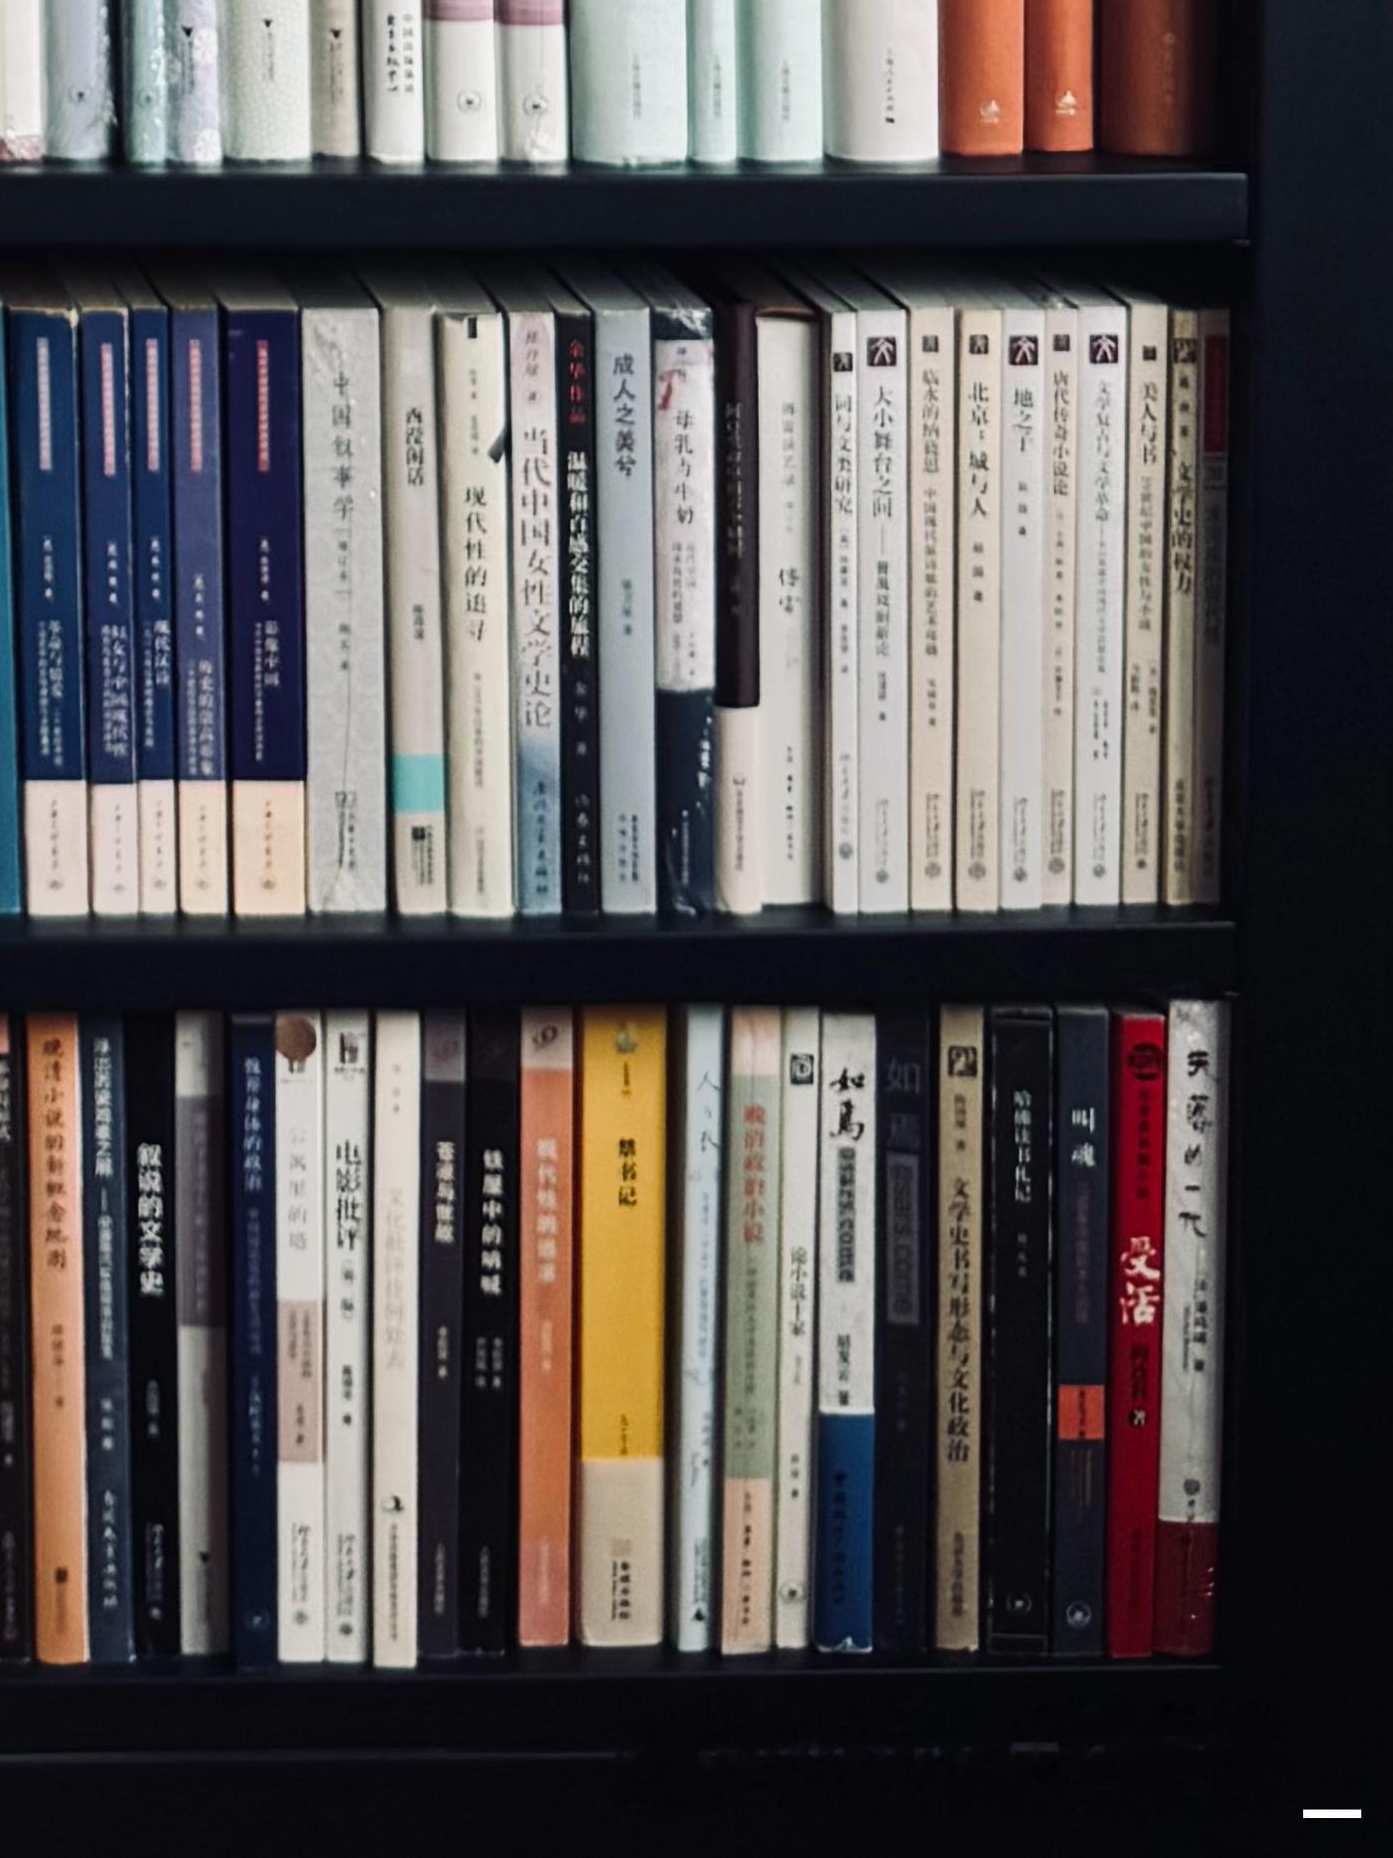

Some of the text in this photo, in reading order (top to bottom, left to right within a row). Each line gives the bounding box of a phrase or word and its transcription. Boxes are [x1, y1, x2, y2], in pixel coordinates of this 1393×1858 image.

[613, 352, 637, 478] 成人之美兮
[872, 385, 893, 519] 大小舞台之间
[1013, 387, 1036, 453] 地之子
[521, 428, 554, 730] 当代中国女性文学史论
[335, 1140, 363, 1252] 电影批评
[1071, 1107, 1096, 1168] 叫魂
[946, 1177, 971, 1463] 文学史书写形态与文化政治
[1120, 1235, 1159, 1325] 受活
